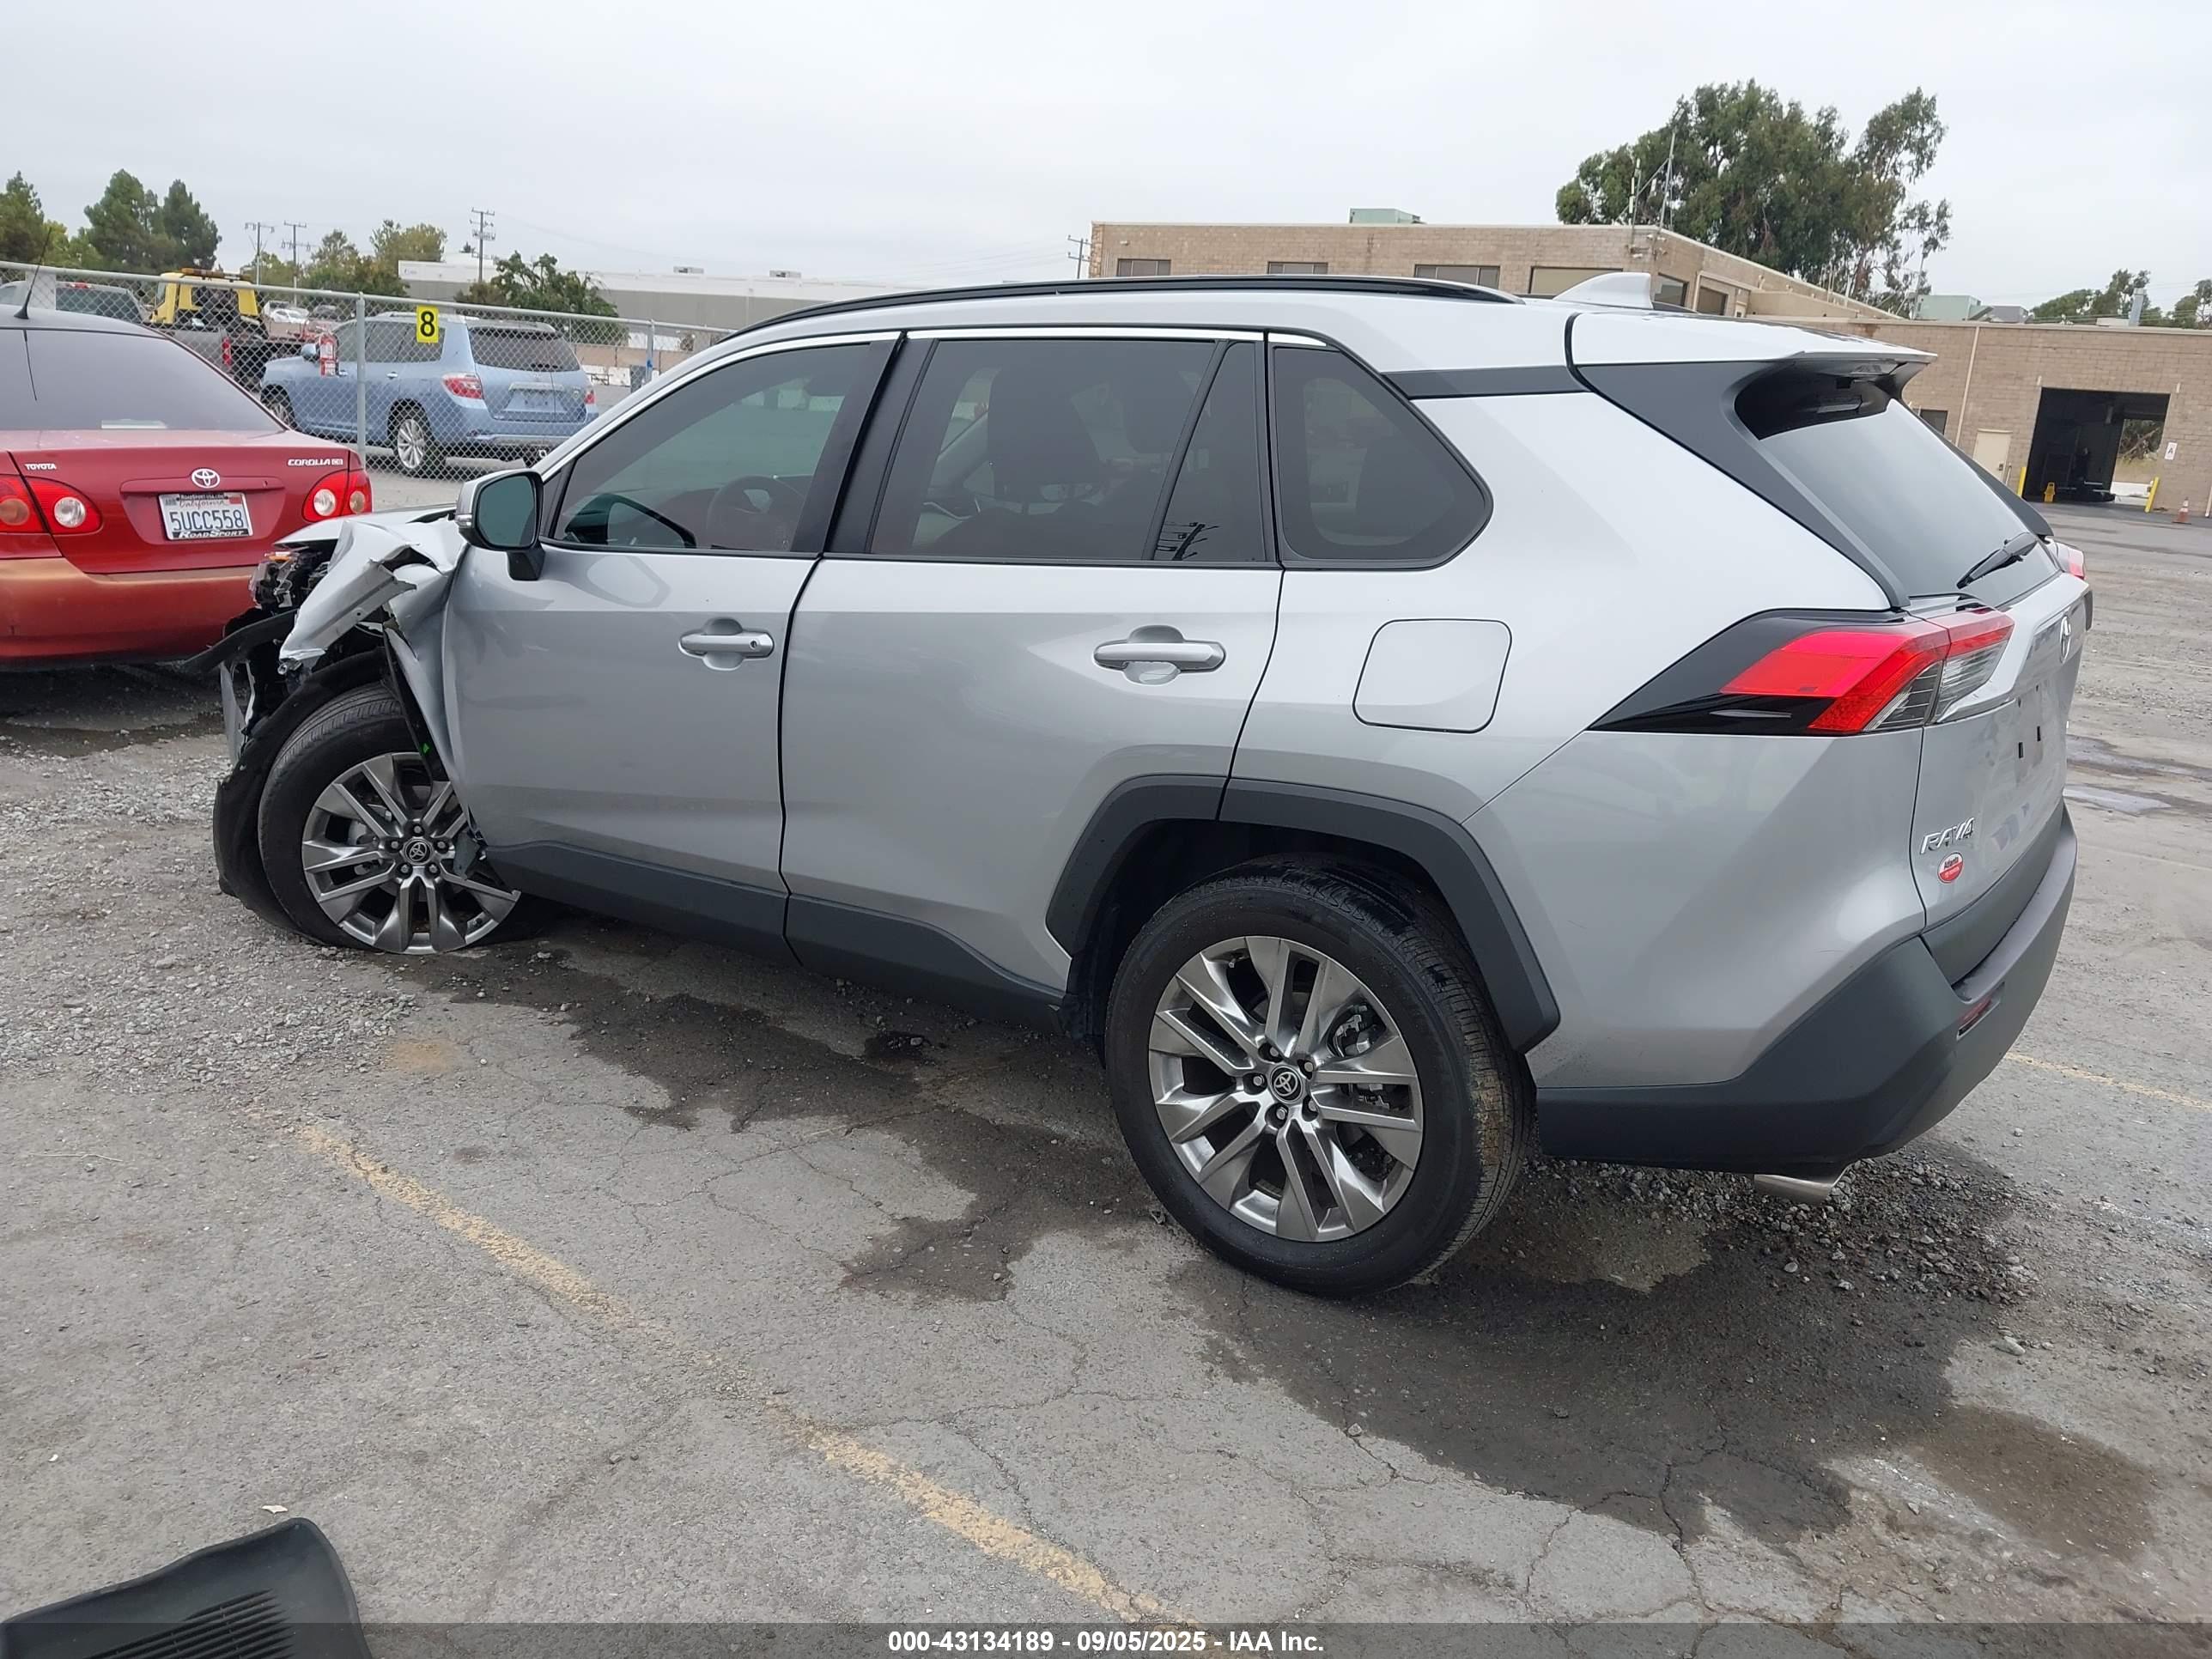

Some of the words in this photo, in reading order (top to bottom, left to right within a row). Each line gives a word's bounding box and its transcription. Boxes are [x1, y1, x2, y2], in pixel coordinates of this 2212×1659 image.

[420, 311, 435, 337] 8
[170, 509, 244, 531] 5UCC558
[1920, 817, 1975, 854] RAV4
